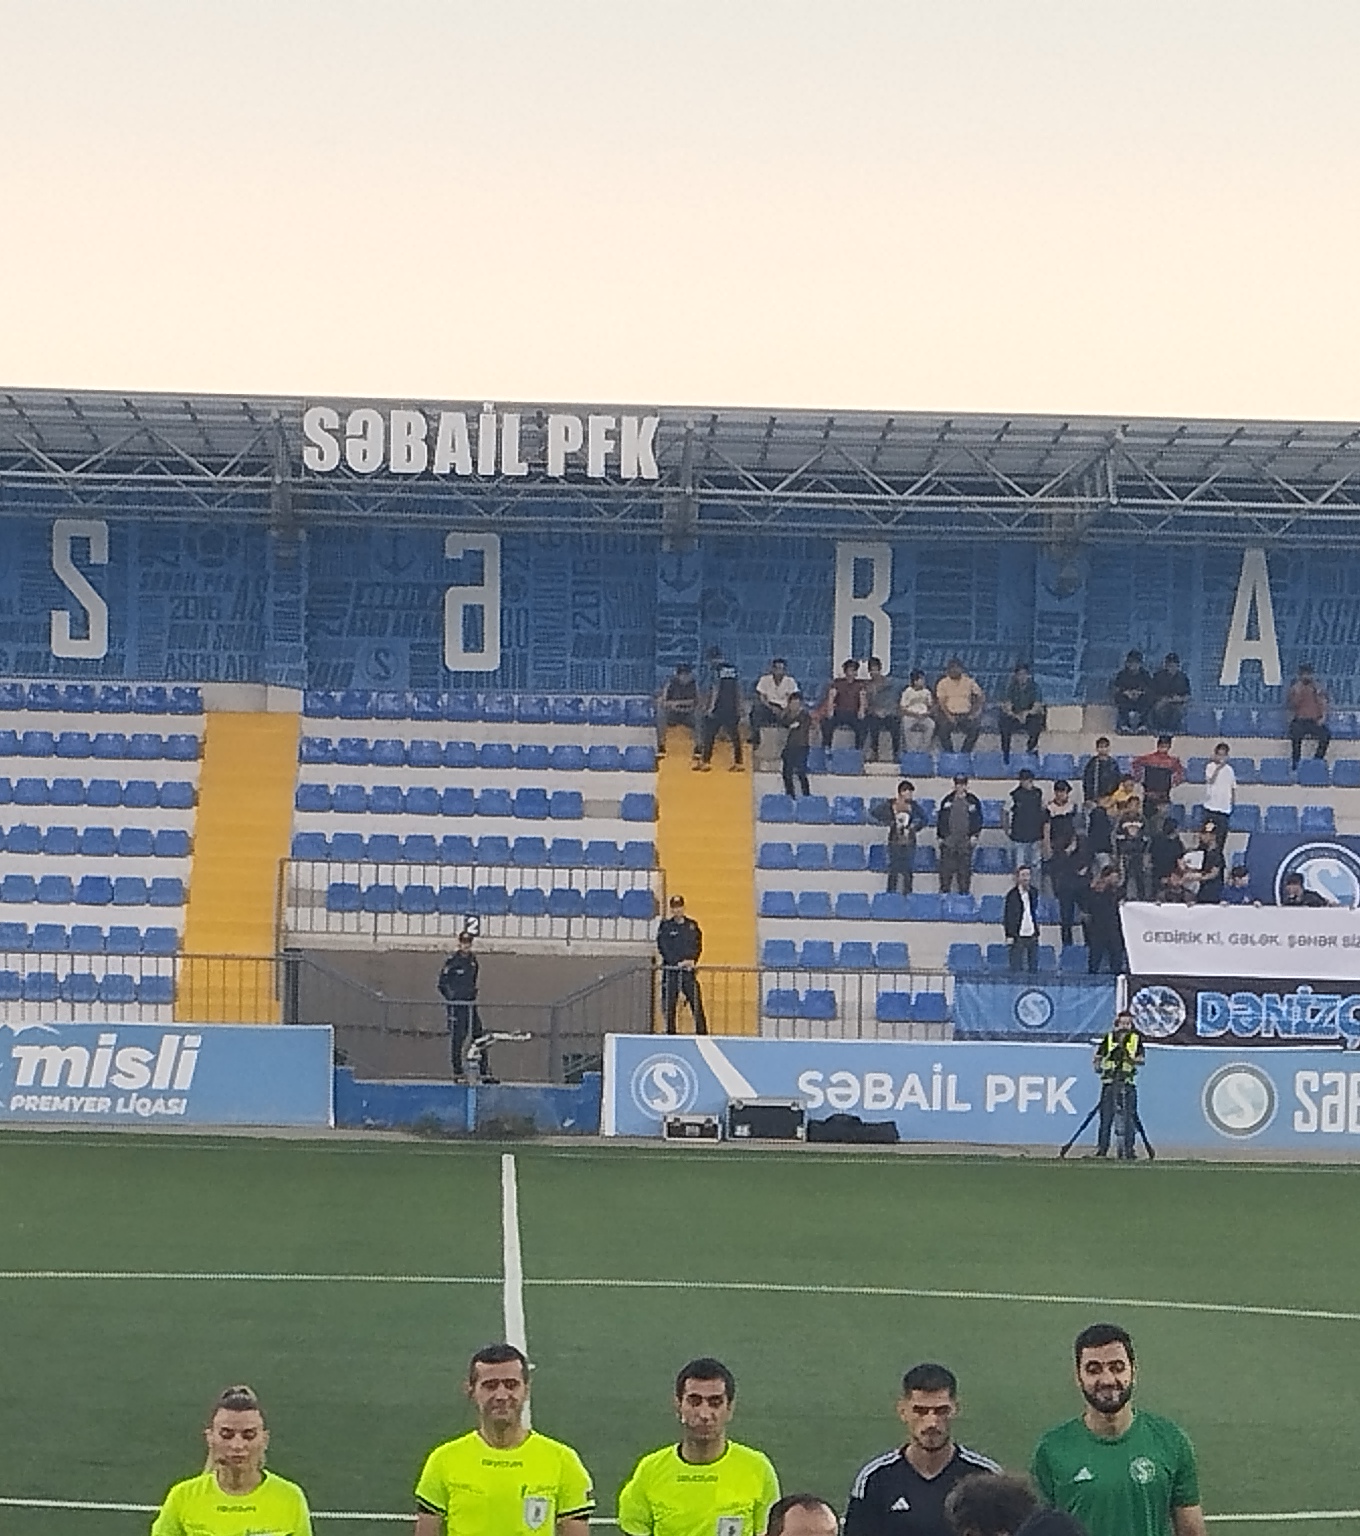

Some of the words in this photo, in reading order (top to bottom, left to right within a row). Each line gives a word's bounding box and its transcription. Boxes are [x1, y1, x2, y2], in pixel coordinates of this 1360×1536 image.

[303, 402, 529, 476] SƏBAİL
[548, 414, 660, 479] PFK
[467, 916, 479, 935] 2
[12, 1033, 202, 1091] misli
[797, 1063, 972, 1112] SƏBAİL
[986, 1074, 1079, 1115] PFK
